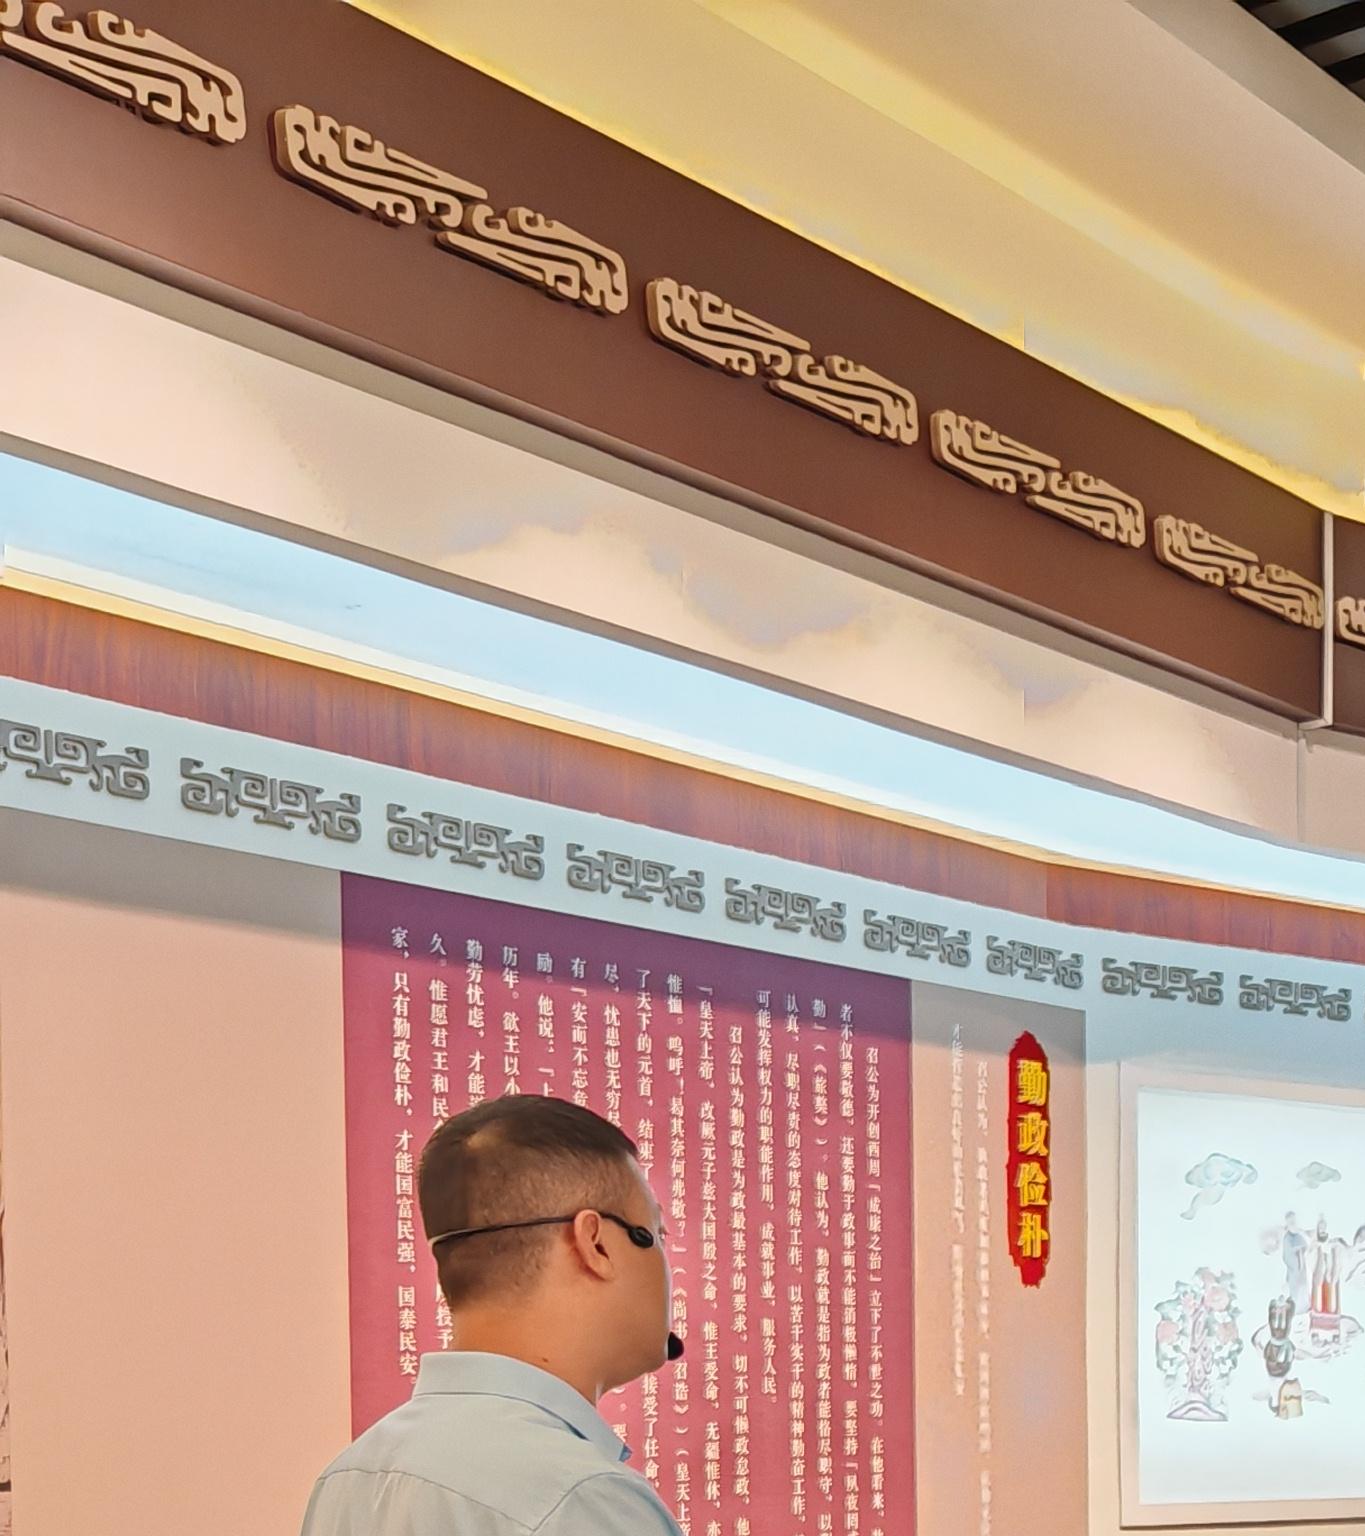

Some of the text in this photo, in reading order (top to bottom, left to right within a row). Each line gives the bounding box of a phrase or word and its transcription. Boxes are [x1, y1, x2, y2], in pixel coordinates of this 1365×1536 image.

[429, 932, 449, 1130] 久。惟愿君王和民
[1016, 1060, 1049, 1259] 勤政俭朴
